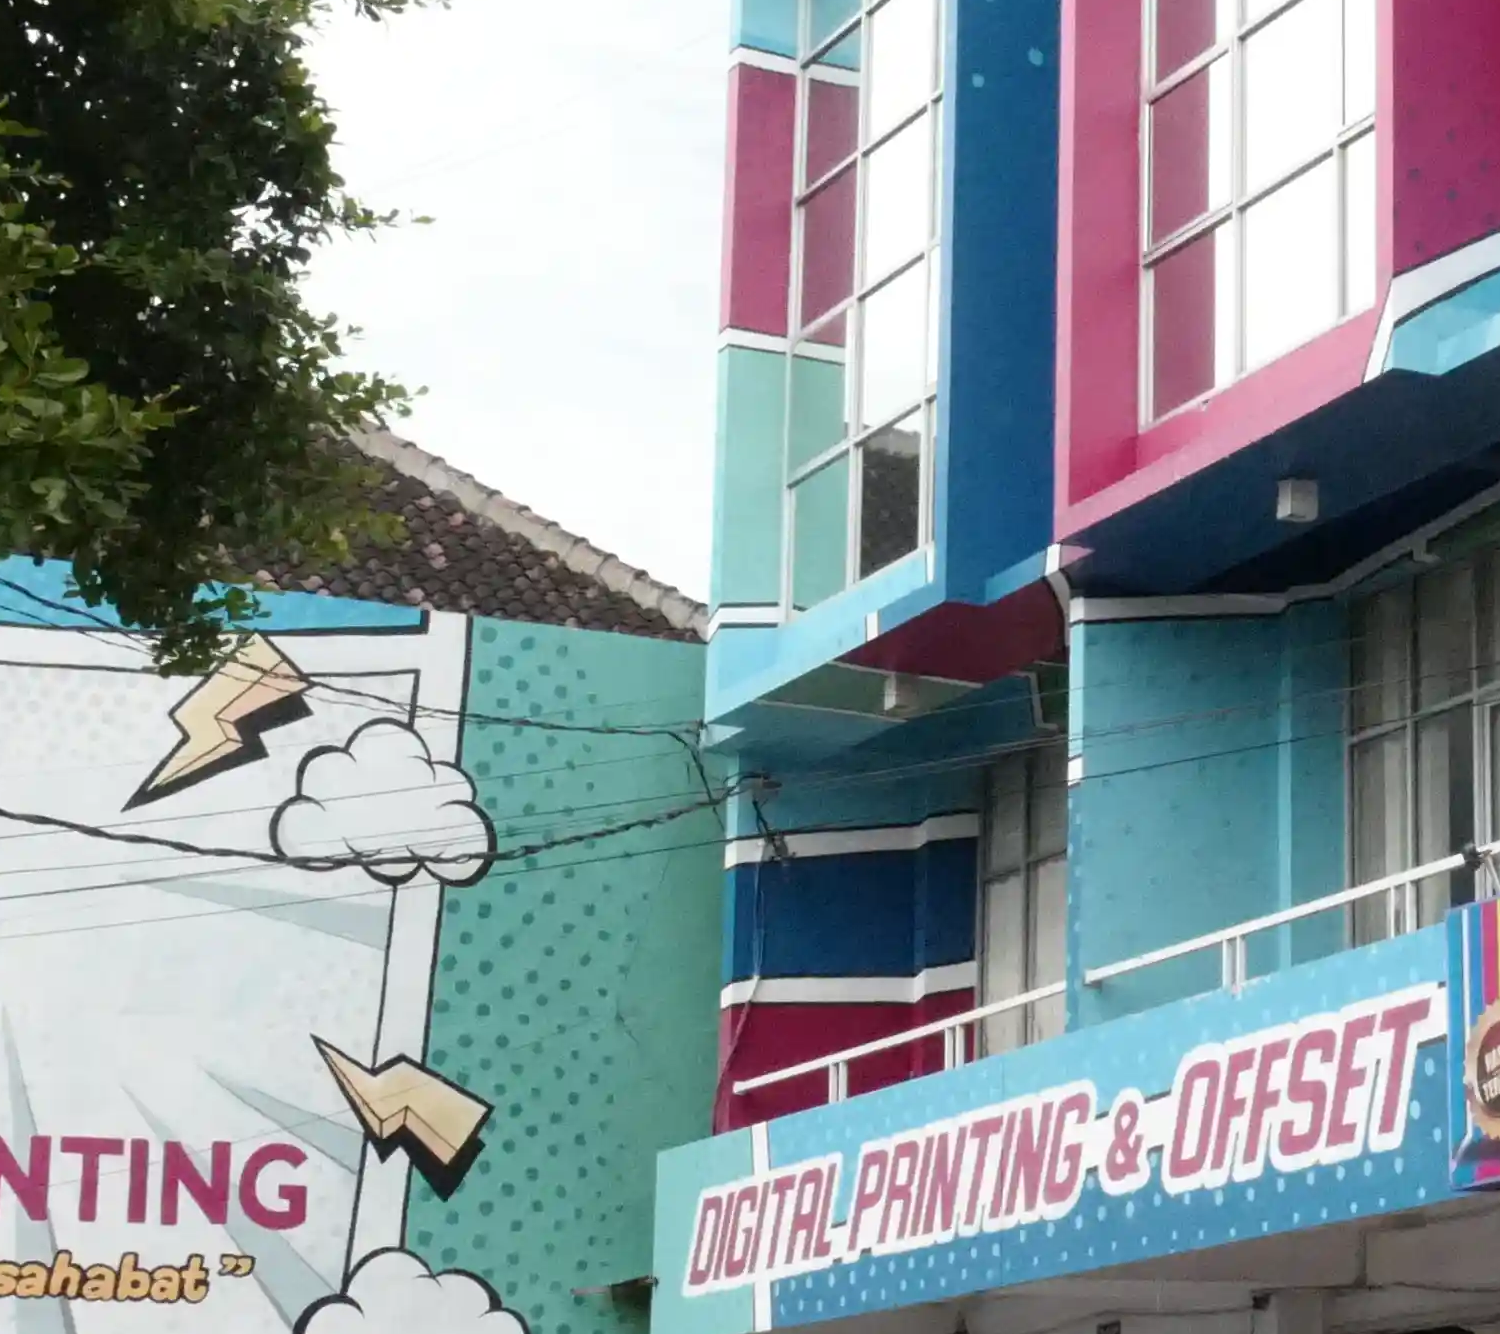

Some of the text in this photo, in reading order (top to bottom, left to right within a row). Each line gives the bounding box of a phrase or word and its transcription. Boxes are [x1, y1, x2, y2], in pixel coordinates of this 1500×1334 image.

[686, 996, 1432, 1289] DIGITAL PRINTING & OFFSET
